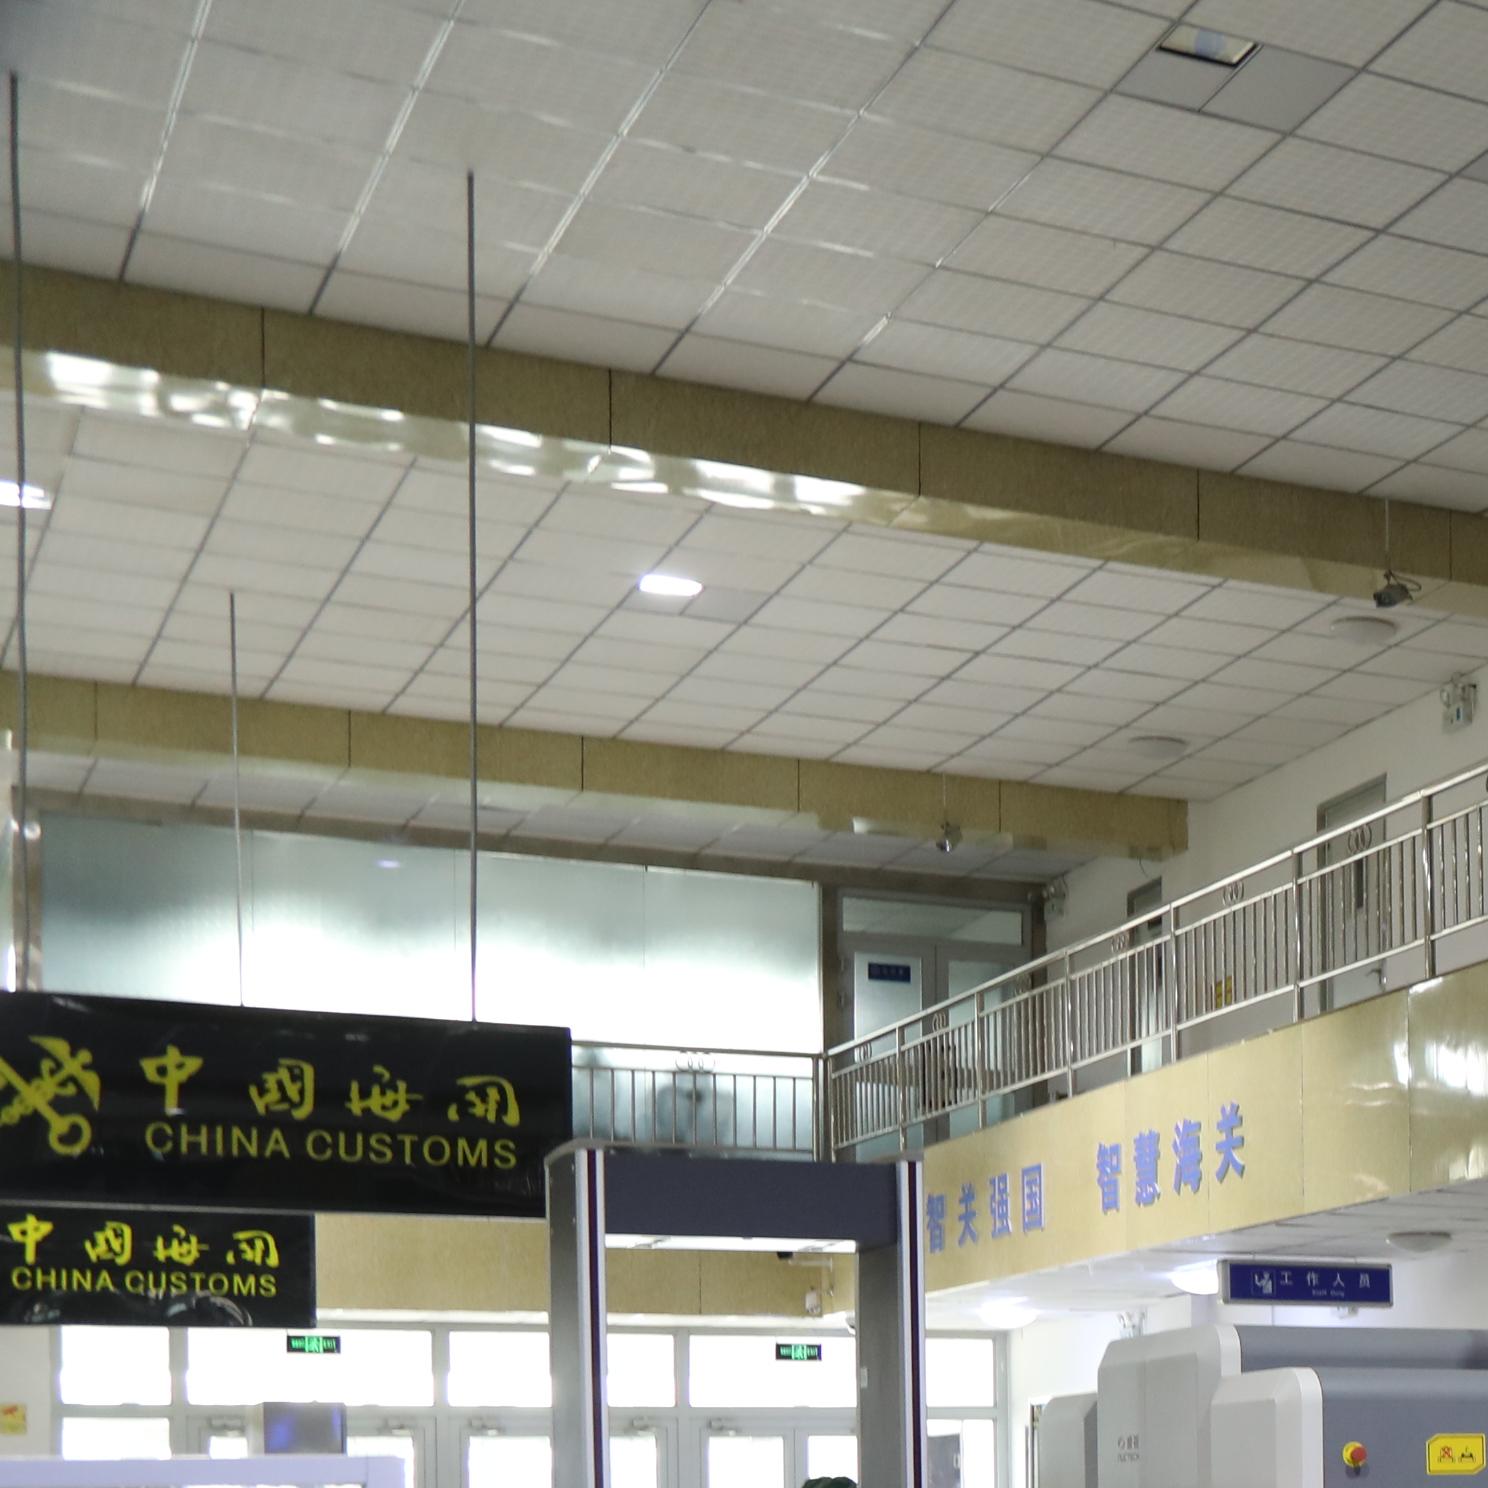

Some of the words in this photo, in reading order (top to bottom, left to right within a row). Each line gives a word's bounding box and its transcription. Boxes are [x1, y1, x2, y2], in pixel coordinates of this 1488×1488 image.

[145, 1122, 290, 1159] CHINA
[306, 1129, 518, 1169] CUSTOMS
[1096, 1099, 1246, 1215] 智慧海关
[926, 1163, 1045, 1254] 智关强国
[11, 1266, 114, 1292] CHINA
[125, 1270, 278, 1298] CUSTOMS
[1279, 1271, 1371, 1288] 工作人员
